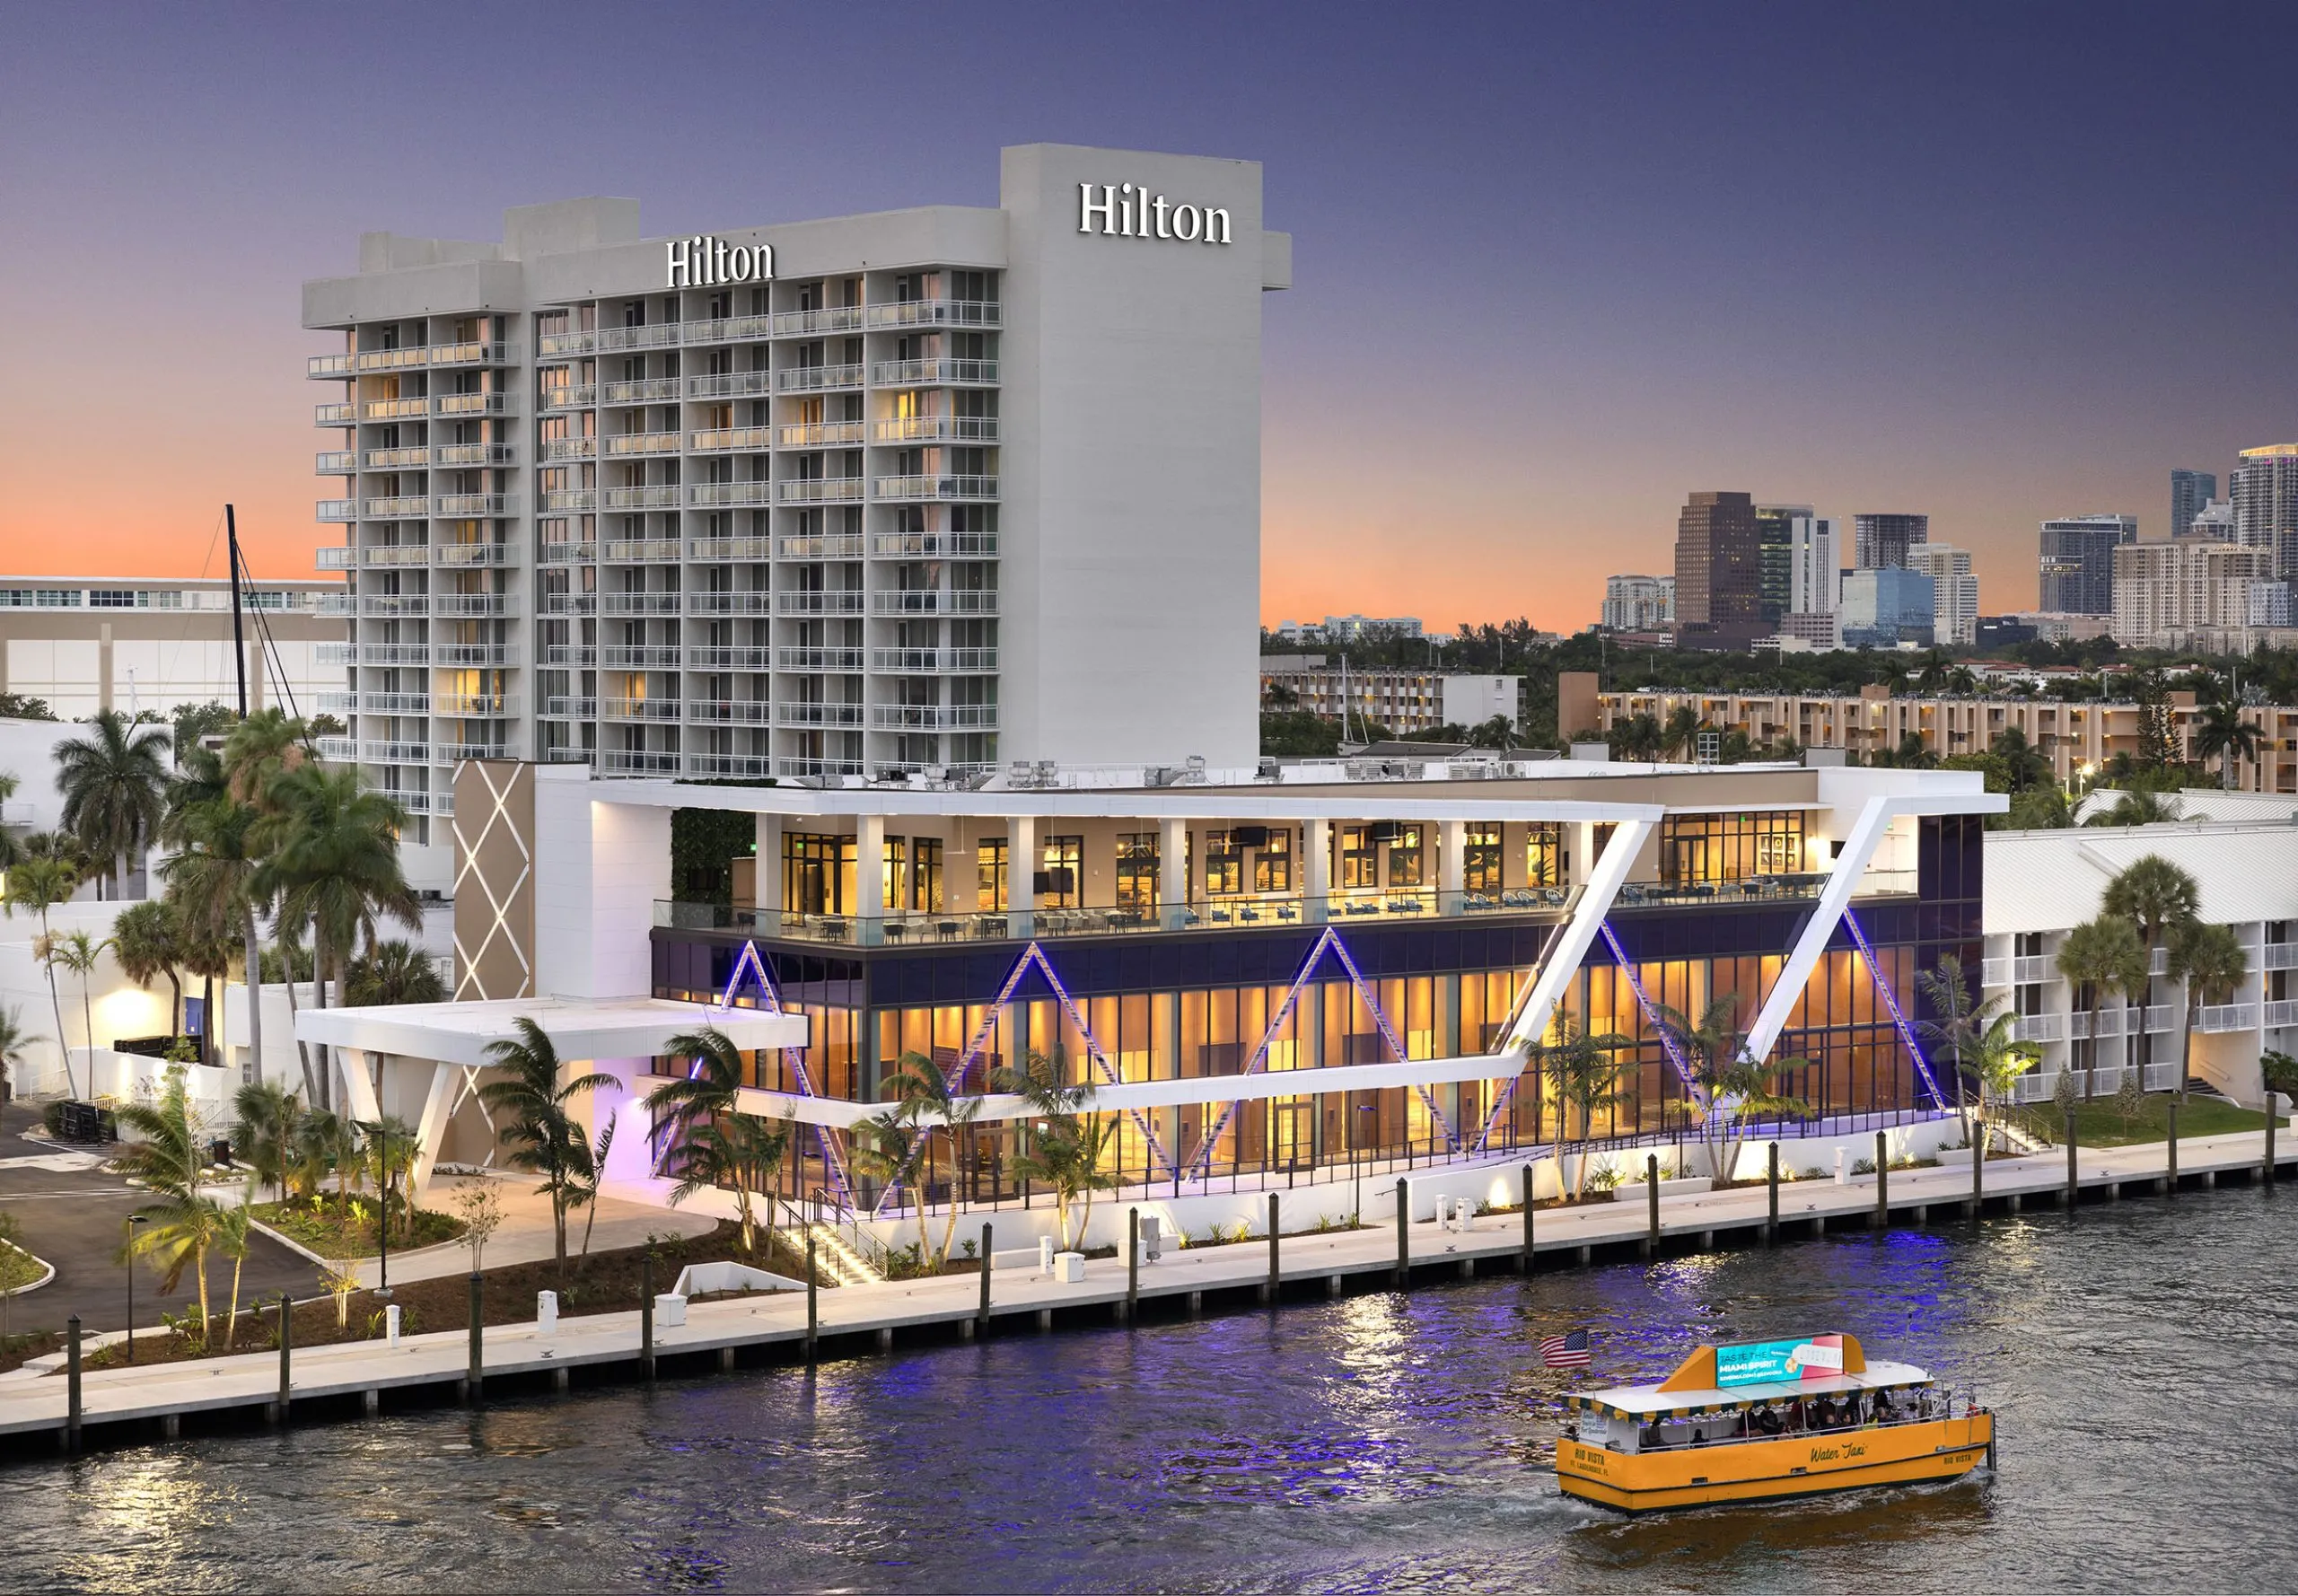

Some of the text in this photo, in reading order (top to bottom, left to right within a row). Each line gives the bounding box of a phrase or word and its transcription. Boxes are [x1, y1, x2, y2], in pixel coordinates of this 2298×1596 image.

[1079, 182, 1232, 243] Hilton
[666, 235, 774, 287] Hilton
[1720, 1352, 1748, 1363] TASTE
[1750, 1350, 1767, 1359] THE
[1719, 1360, 1778, 1373] MIAMI SPIRIT
[1575, 1448, 1605, 1466] RIO VISTA
[1810, 1442, 1866, 1462] Water Taxi
[1943, 1454, 1971, 1465] RIO VISTA
